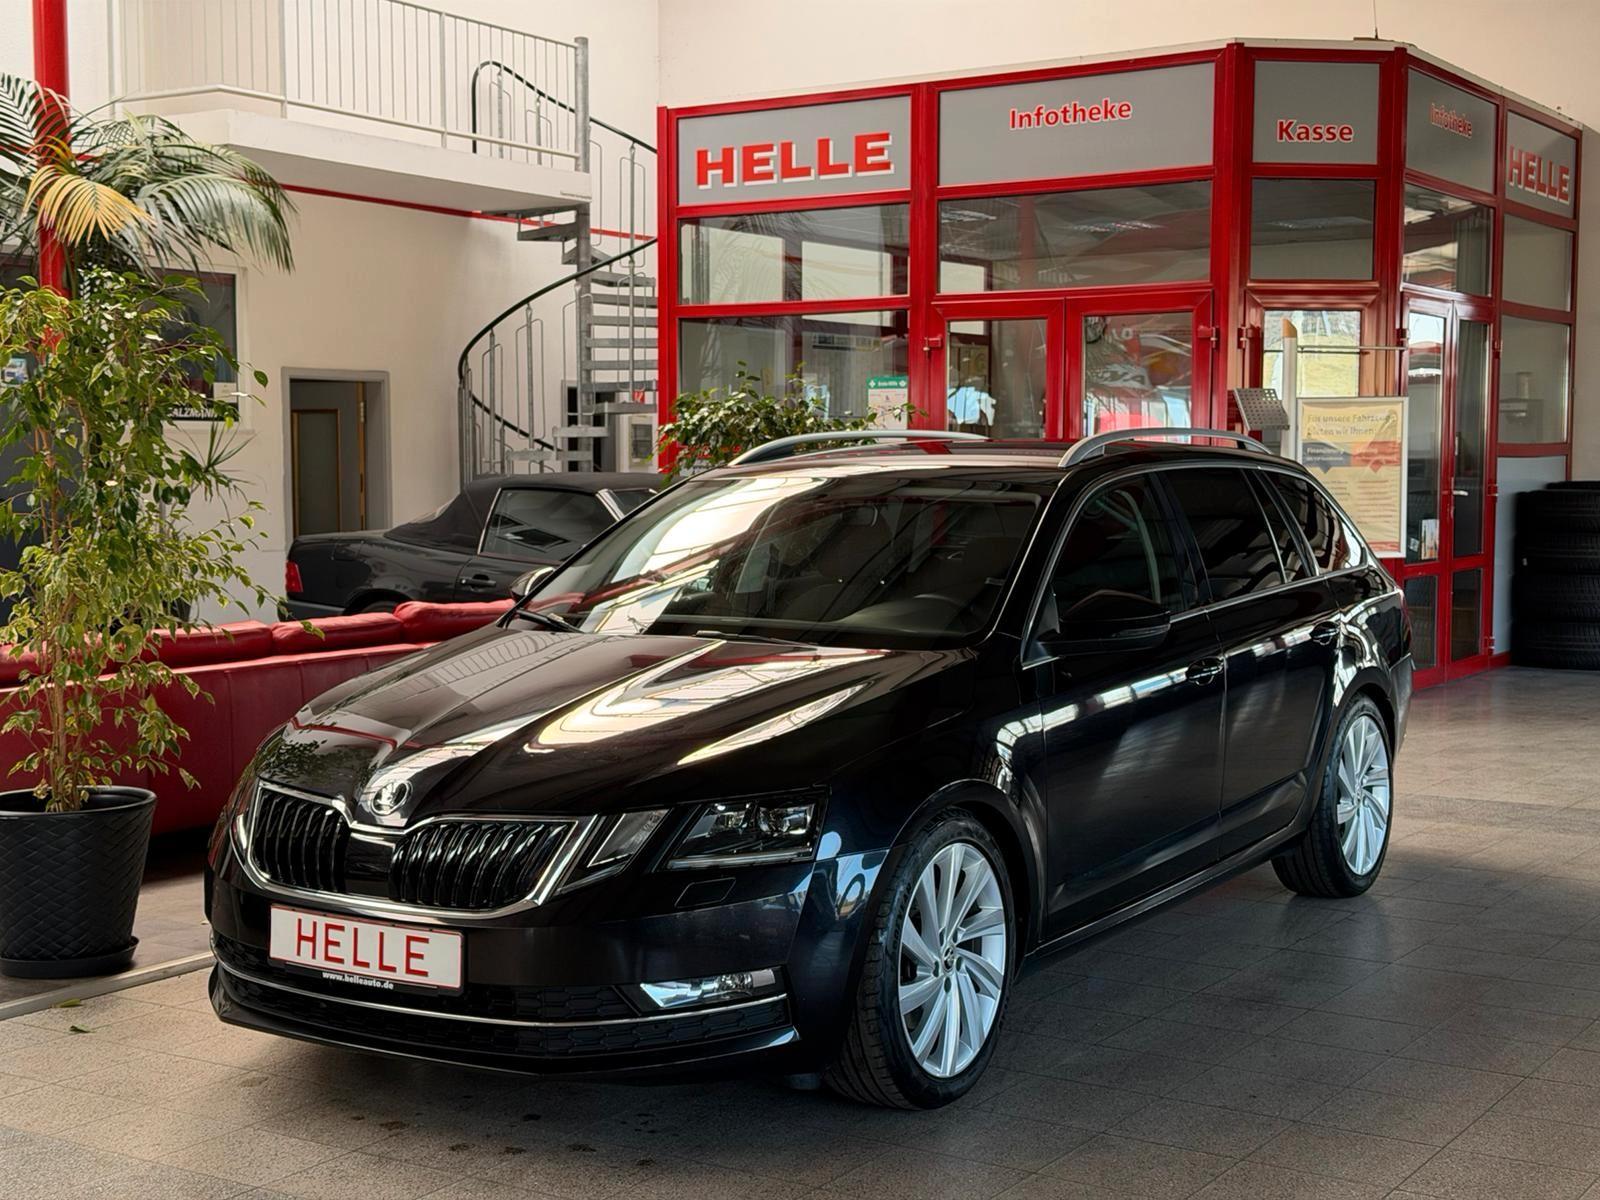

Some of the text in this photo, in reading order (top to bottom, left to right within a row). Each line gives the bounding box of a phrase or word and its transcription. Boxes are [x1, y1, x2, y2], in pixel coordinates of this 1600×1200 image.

[1009, 98, 1133, 131] Infotheke
[1277, 119, 1354, 143] Kasse
[1430, 102, 1473, 139] Infotheke
[696, 131, 895, 190] HELLE
[1508, 145, 1570, 205] HELLE
[297, 918, 430, 977] HELLE
[322, 971, 394, 990] www.helleauto.de
